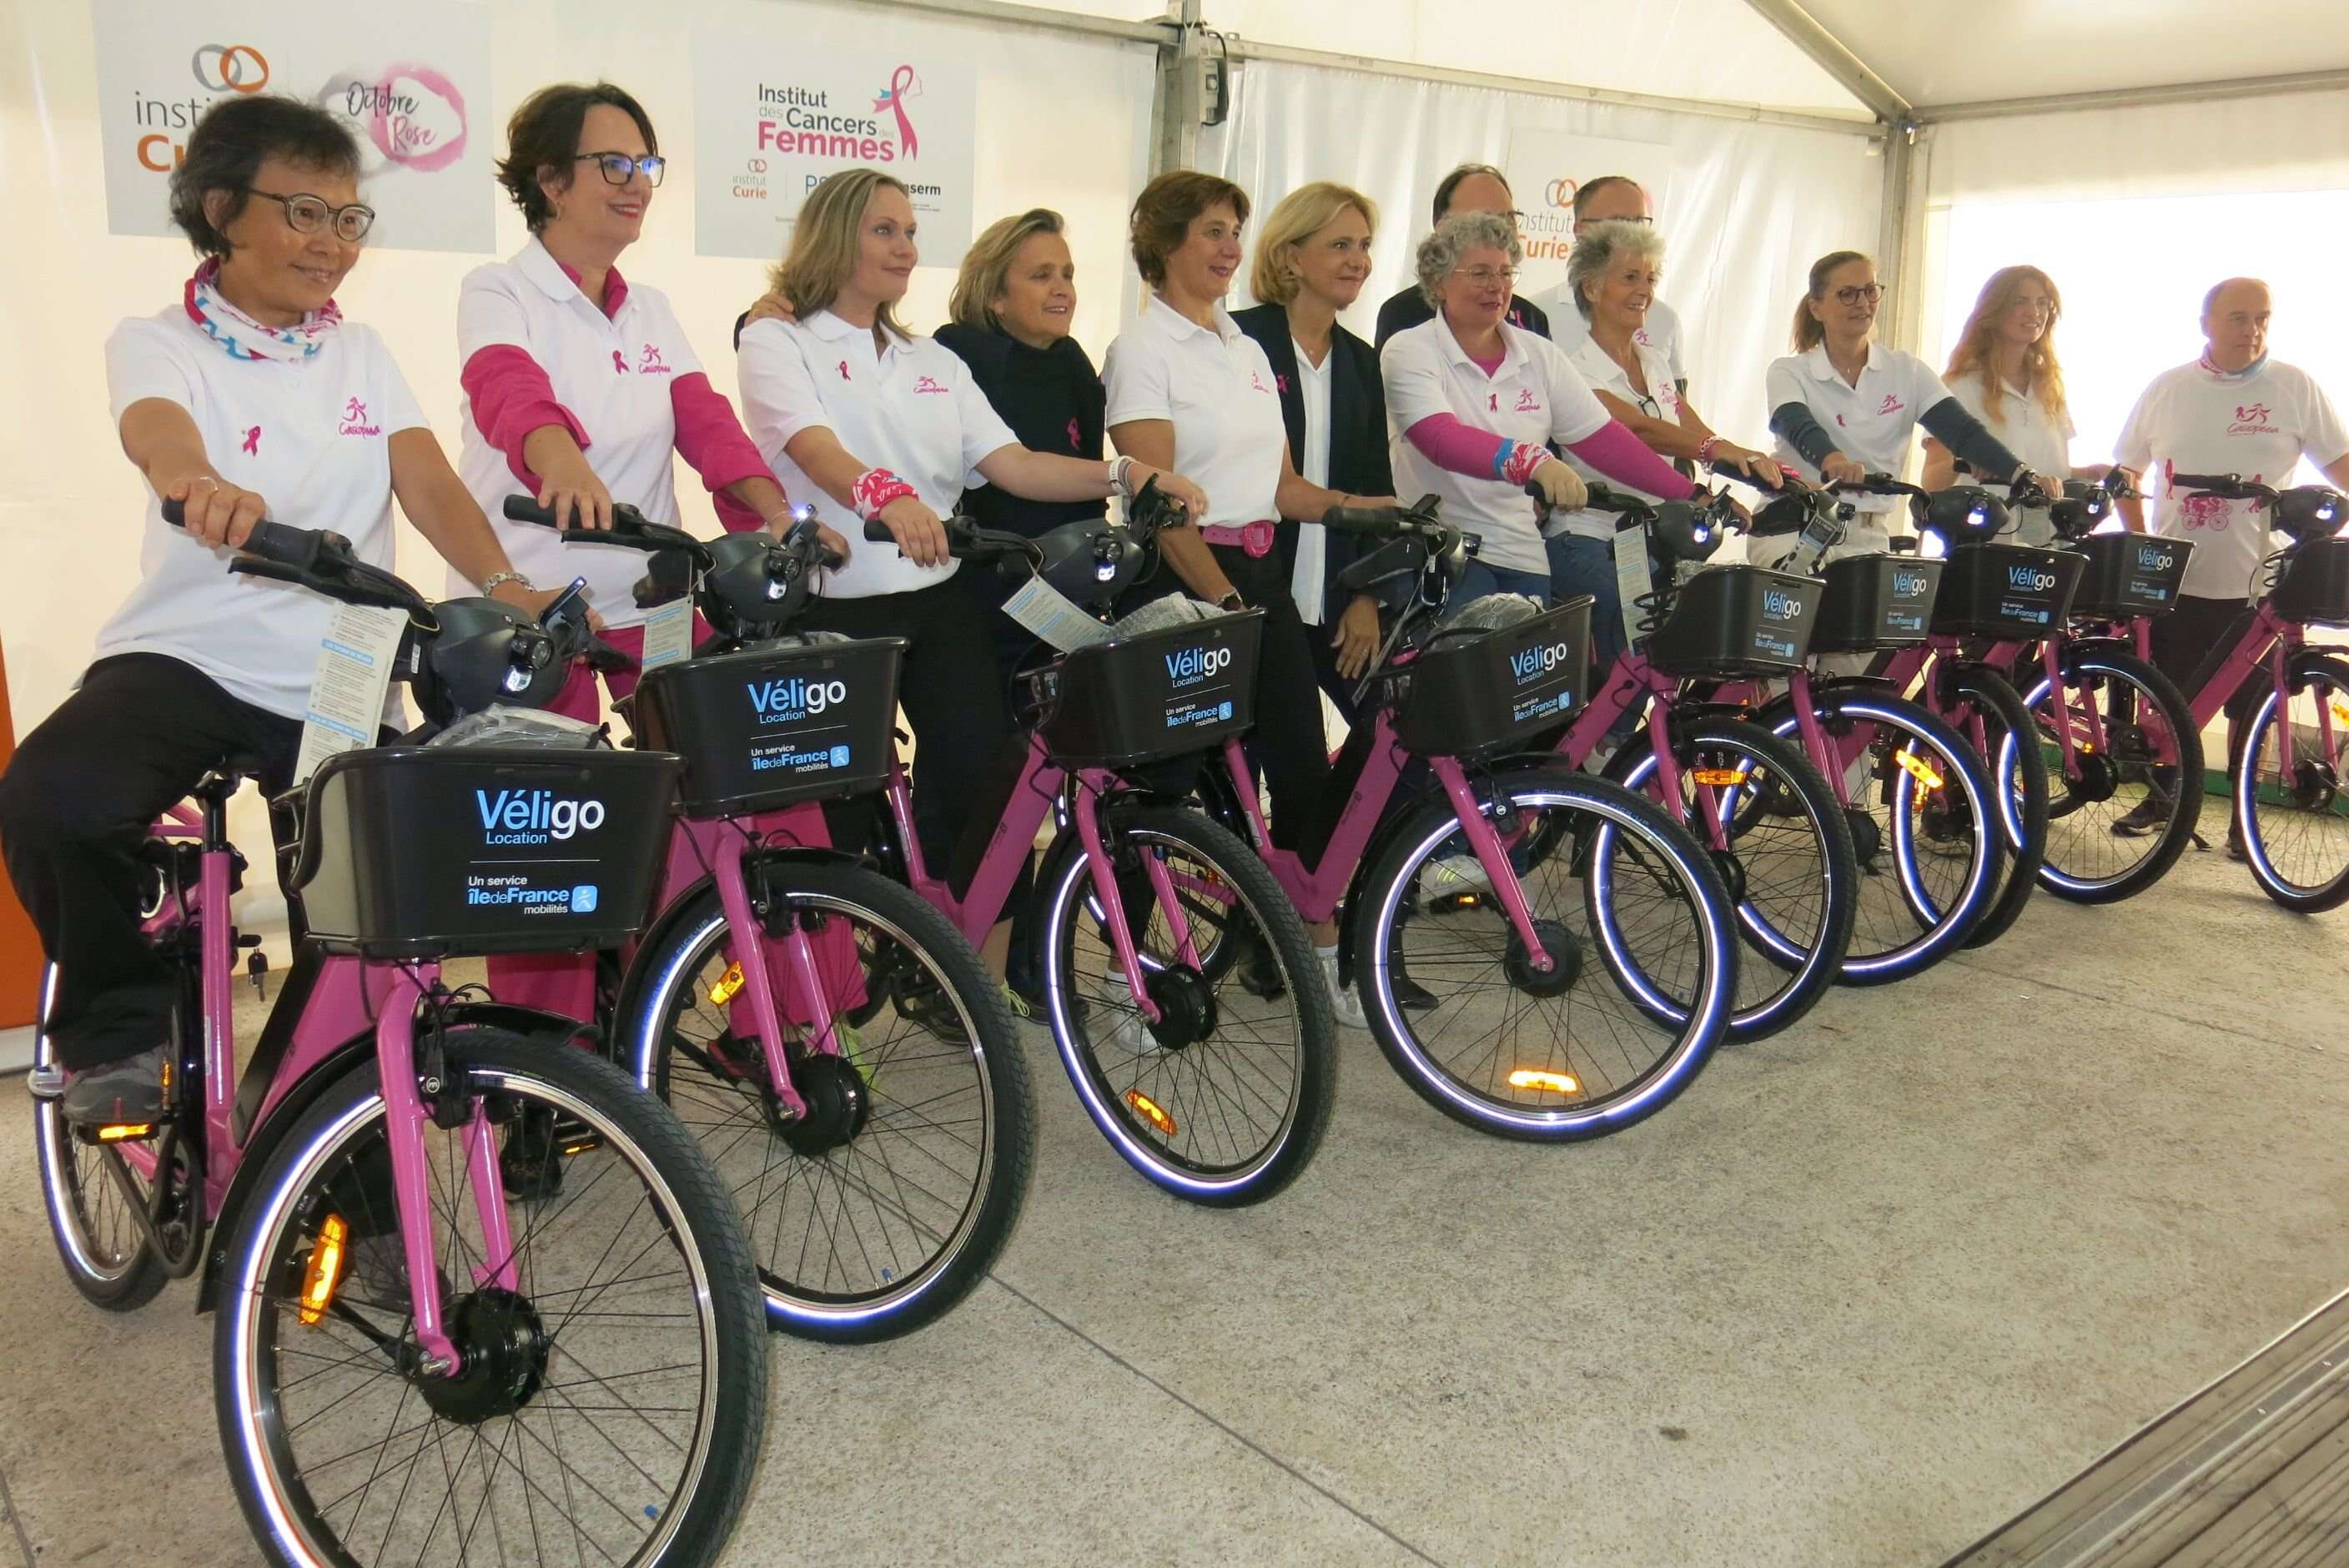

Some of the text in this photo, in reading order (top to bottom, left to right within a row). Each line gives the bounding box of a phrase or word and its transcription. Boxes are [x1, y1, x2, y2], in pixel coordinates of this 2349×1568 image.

[346, 81, 420, 118] Octobre
[758, 83, 827, 108] Institut
[135, 91, 210, 128] inst
[759, 105, 783, 119] des
[786, 107, 878, 137] Cancers
[393, 115, 437, 152] Rose
[758, 121, 895, 162] Femmes
[732, 174, 767, 186] institut
[732, 185, 767, 199] Curie
[2138, 547, 2173, 571] Véligo
[1894, 573, 1927, 597] Véligo
[2009, 565, 2056, 591] Véligo
[1763, 589, 1802, 620] Véligo
[1164, 647, 1231, 679] Véligo
[1510, 643, 1567, 677] Véligo
[1172, 675, 1204, 688] Location
[1517, 670, 1545, 686] Location
[747, 677, 847, 714] Véligo
[759, 711, 806, 724] Location
[1174, 703, 1196, 713] service
[751, 744, 796, 756] Un service
[795, 761, 829, 773] mobilités
[476, 789, 606, 840] Véligo
[485, 832, 548, 845] Location
[468, 876, 528, 887] Un service
[524, 904, 569, 915] mobilités
